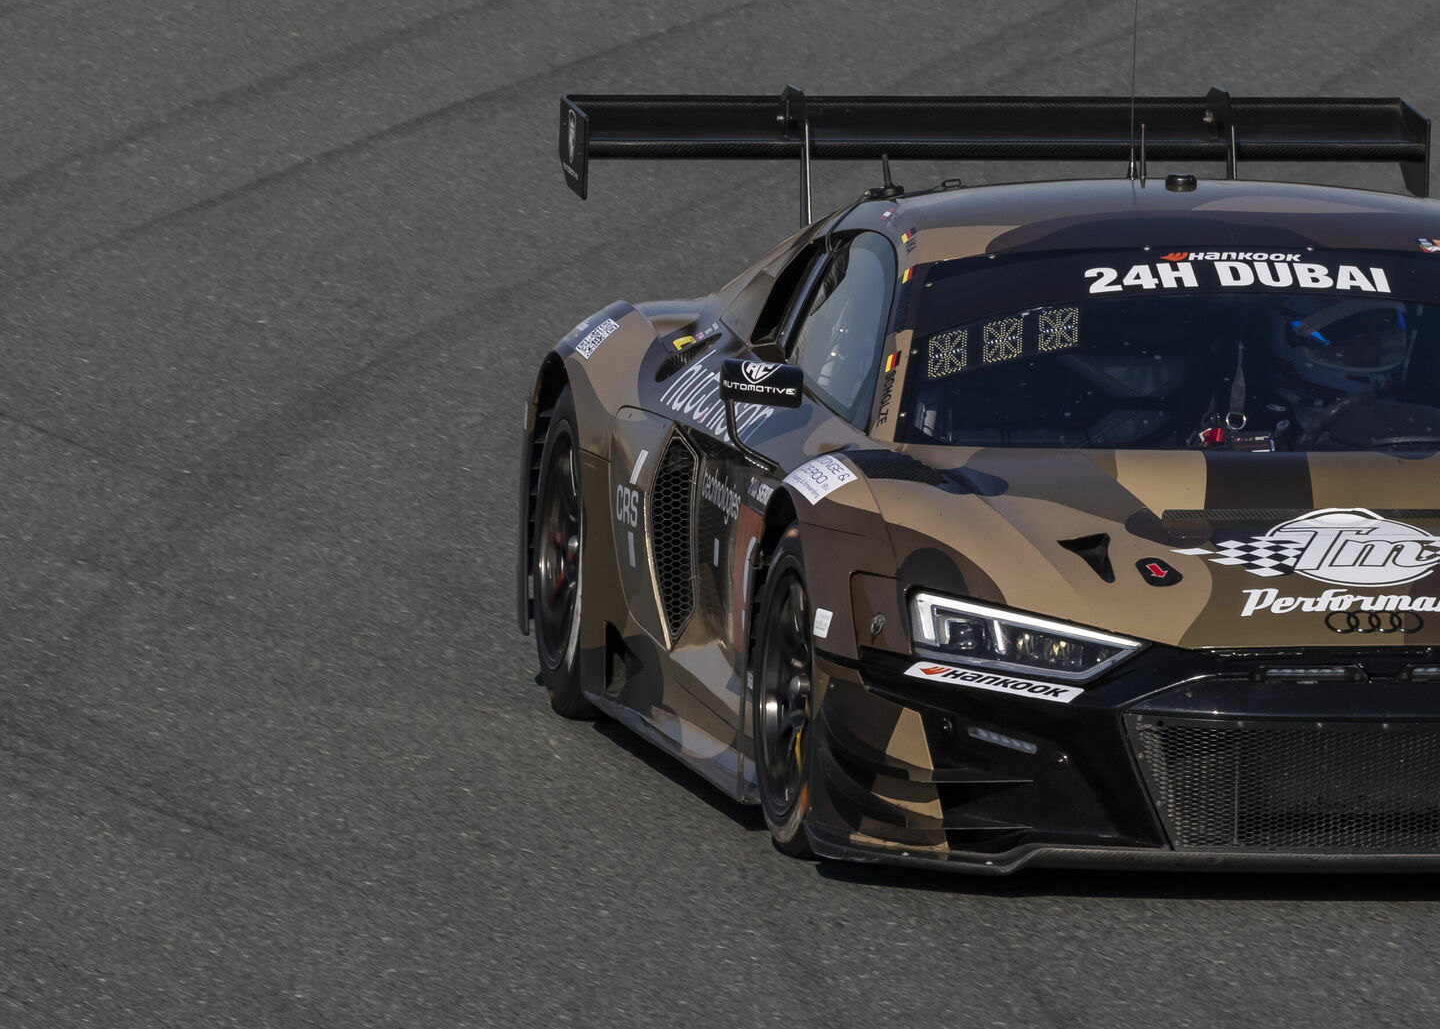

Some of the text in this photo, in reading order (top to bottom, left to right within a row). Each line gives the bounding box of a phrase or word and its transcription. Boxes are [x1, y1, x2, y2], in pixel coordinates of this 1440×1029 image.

[1085, 261, 1392, 294] 24H DUBAI
[723, 380, 796, 395] AUTOMOTIVE
[616, 484, 639, 528] CRS
